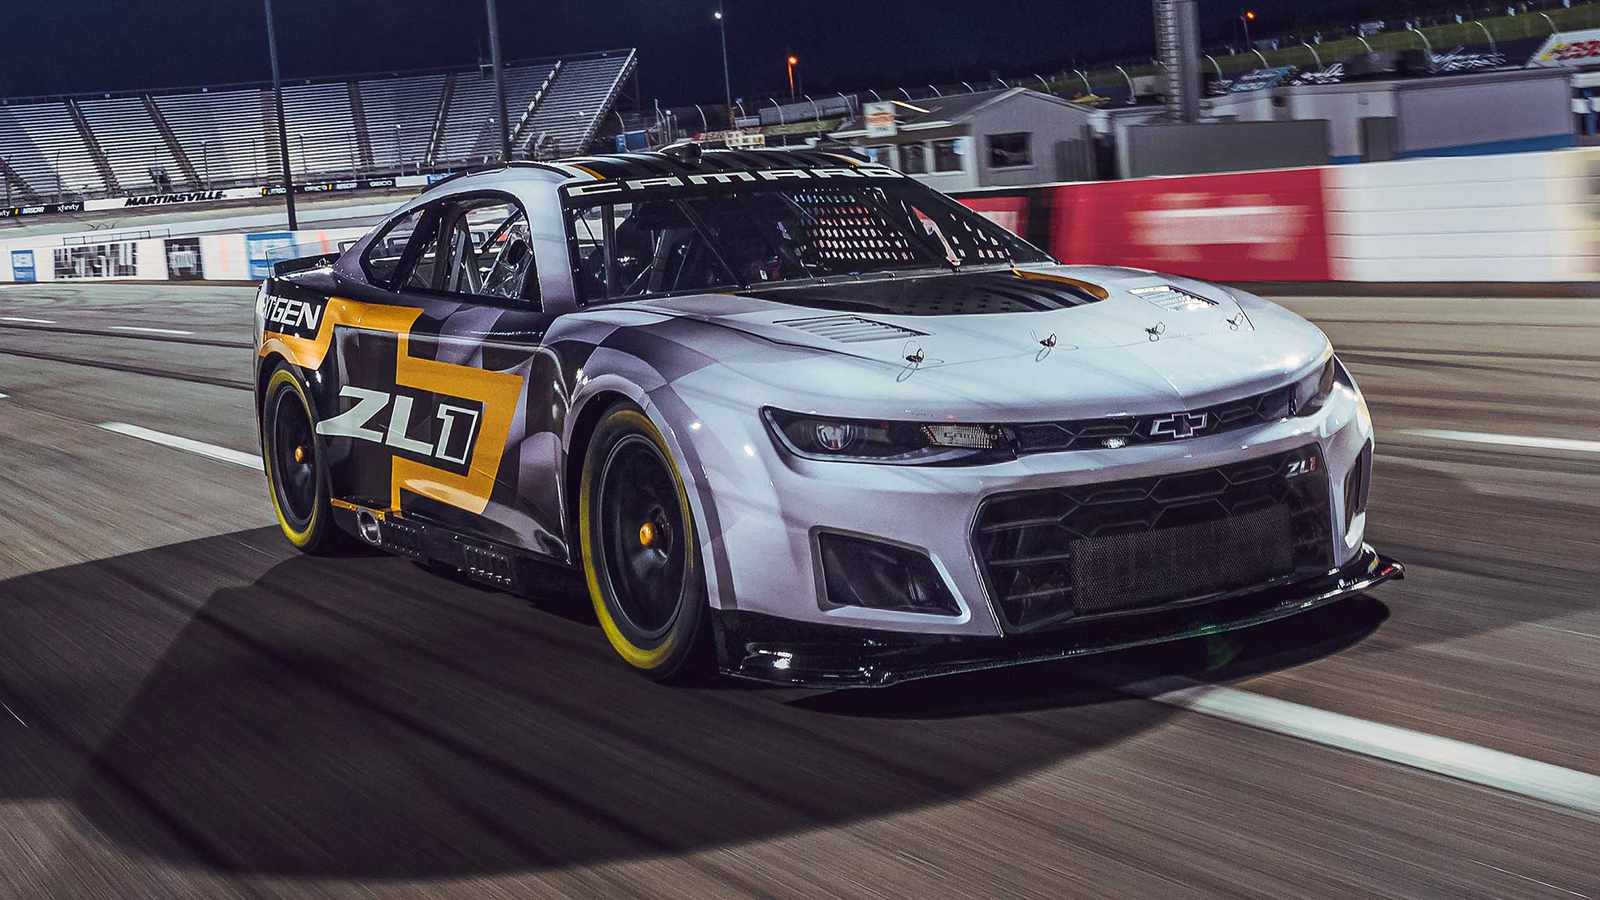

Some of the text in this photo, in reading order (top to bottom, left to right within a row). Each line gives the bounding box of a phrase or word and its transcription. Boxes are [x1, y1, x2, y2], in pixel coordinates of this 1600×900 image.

[566, 167, 904, 197] CAMARO
[124, 190, 224, 207] MARTINSVILLE
[316, 385, 479, 465] ZL1
